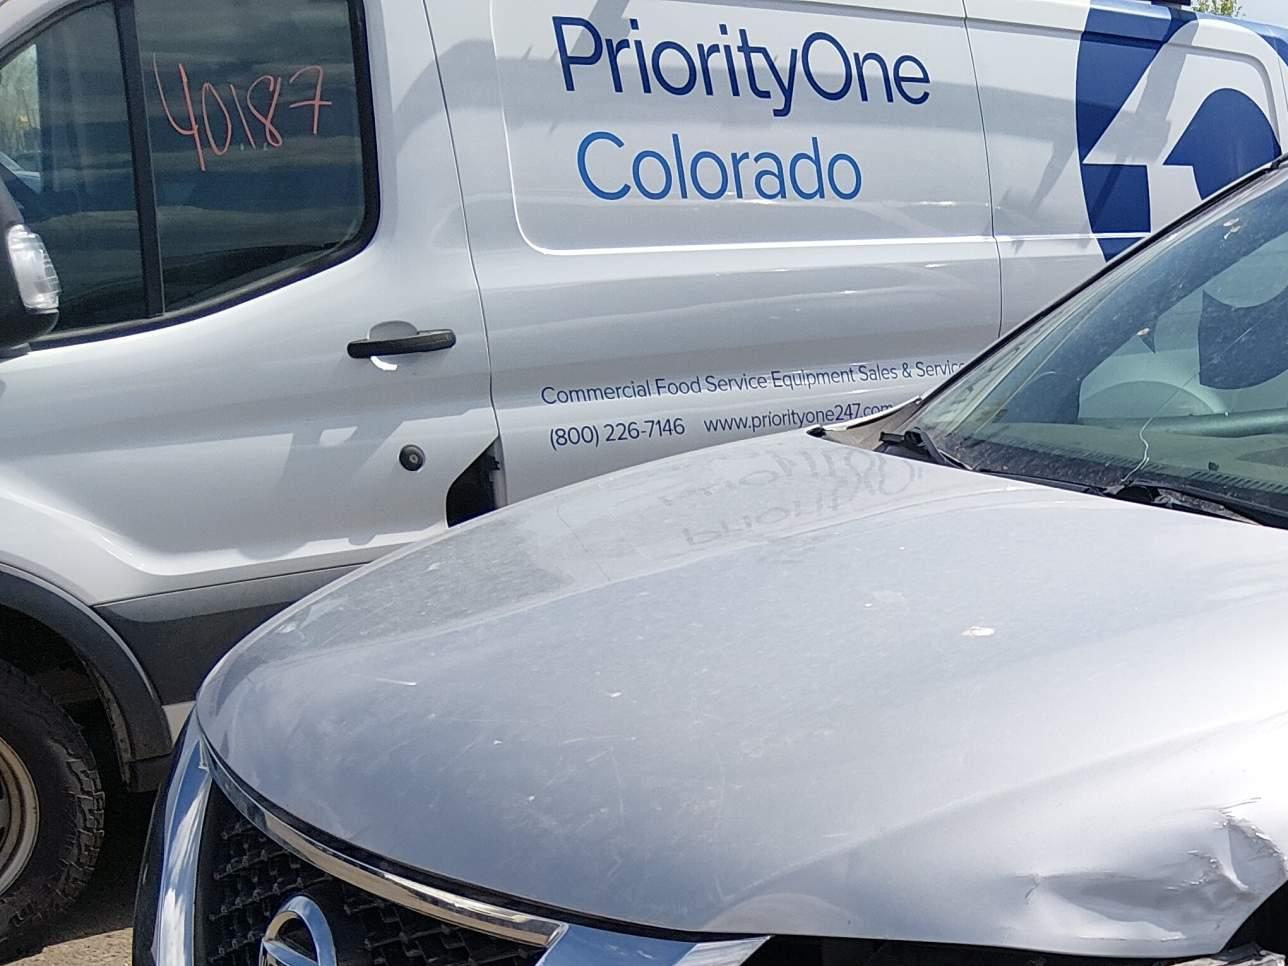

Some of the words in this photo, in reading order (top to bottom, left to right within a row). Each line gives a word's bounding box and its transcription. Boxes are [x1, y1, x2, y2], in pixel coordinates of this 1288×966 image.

[552, 15, 931, 118] PriorityOne
[153, 52, 332, 171] 40187
[577, 131, 862, 200] Colorado
[541, 380, 651, 405] Commercial
[655, 376, 701, 396] Food
[705, 373, 768, 393] Service
[771, 369, 855, 391] Equipment
[858, 363, 898, 382] Sales
[902, 362, 912, 378] &
[550, 424, 600, 451] (800)
[603, 417, 686, 442] 226-7146
